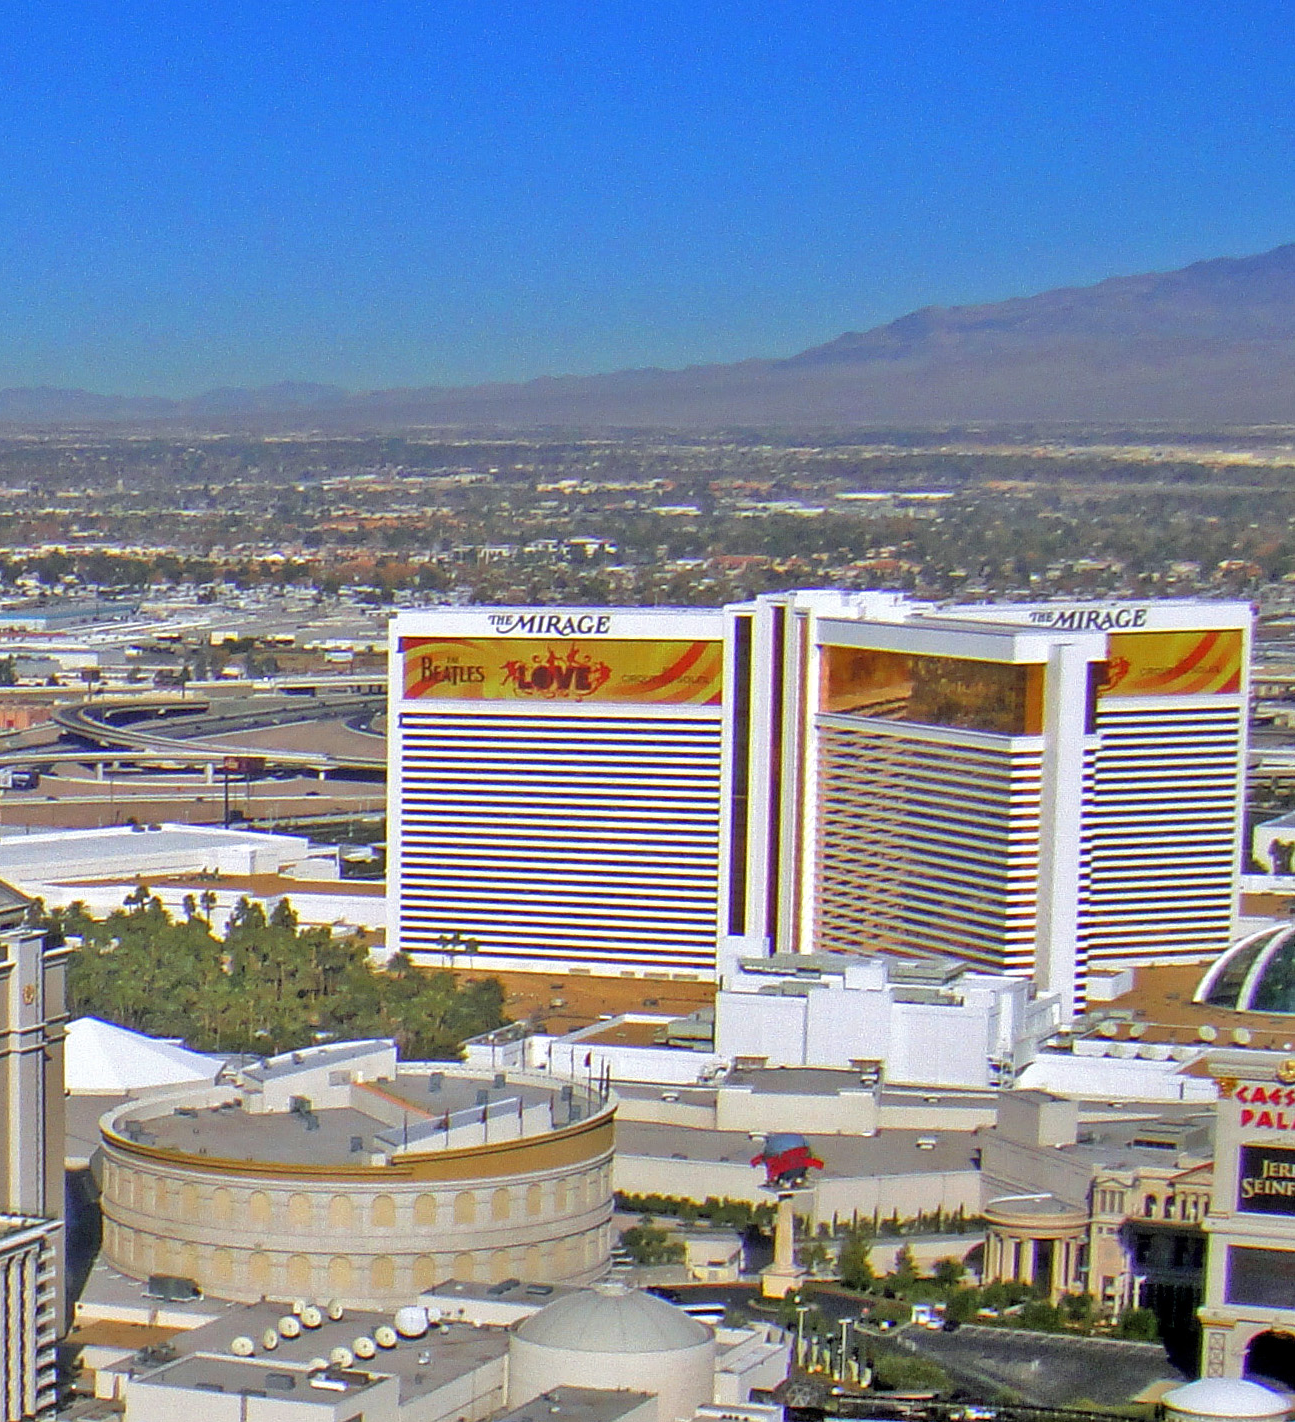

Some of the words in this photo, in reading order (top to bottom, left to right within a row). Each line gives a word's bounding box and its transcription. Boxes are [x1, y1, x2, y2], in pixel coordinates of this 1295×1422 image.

[488, 615, 513, 625] THE
[496, 615, 610, 636] MIRAGE
[1030, 611, 1054, 622] THE
[1051, 609, 1147, 631] MIRAGE
[517, 665, 592, 690] LOVE
